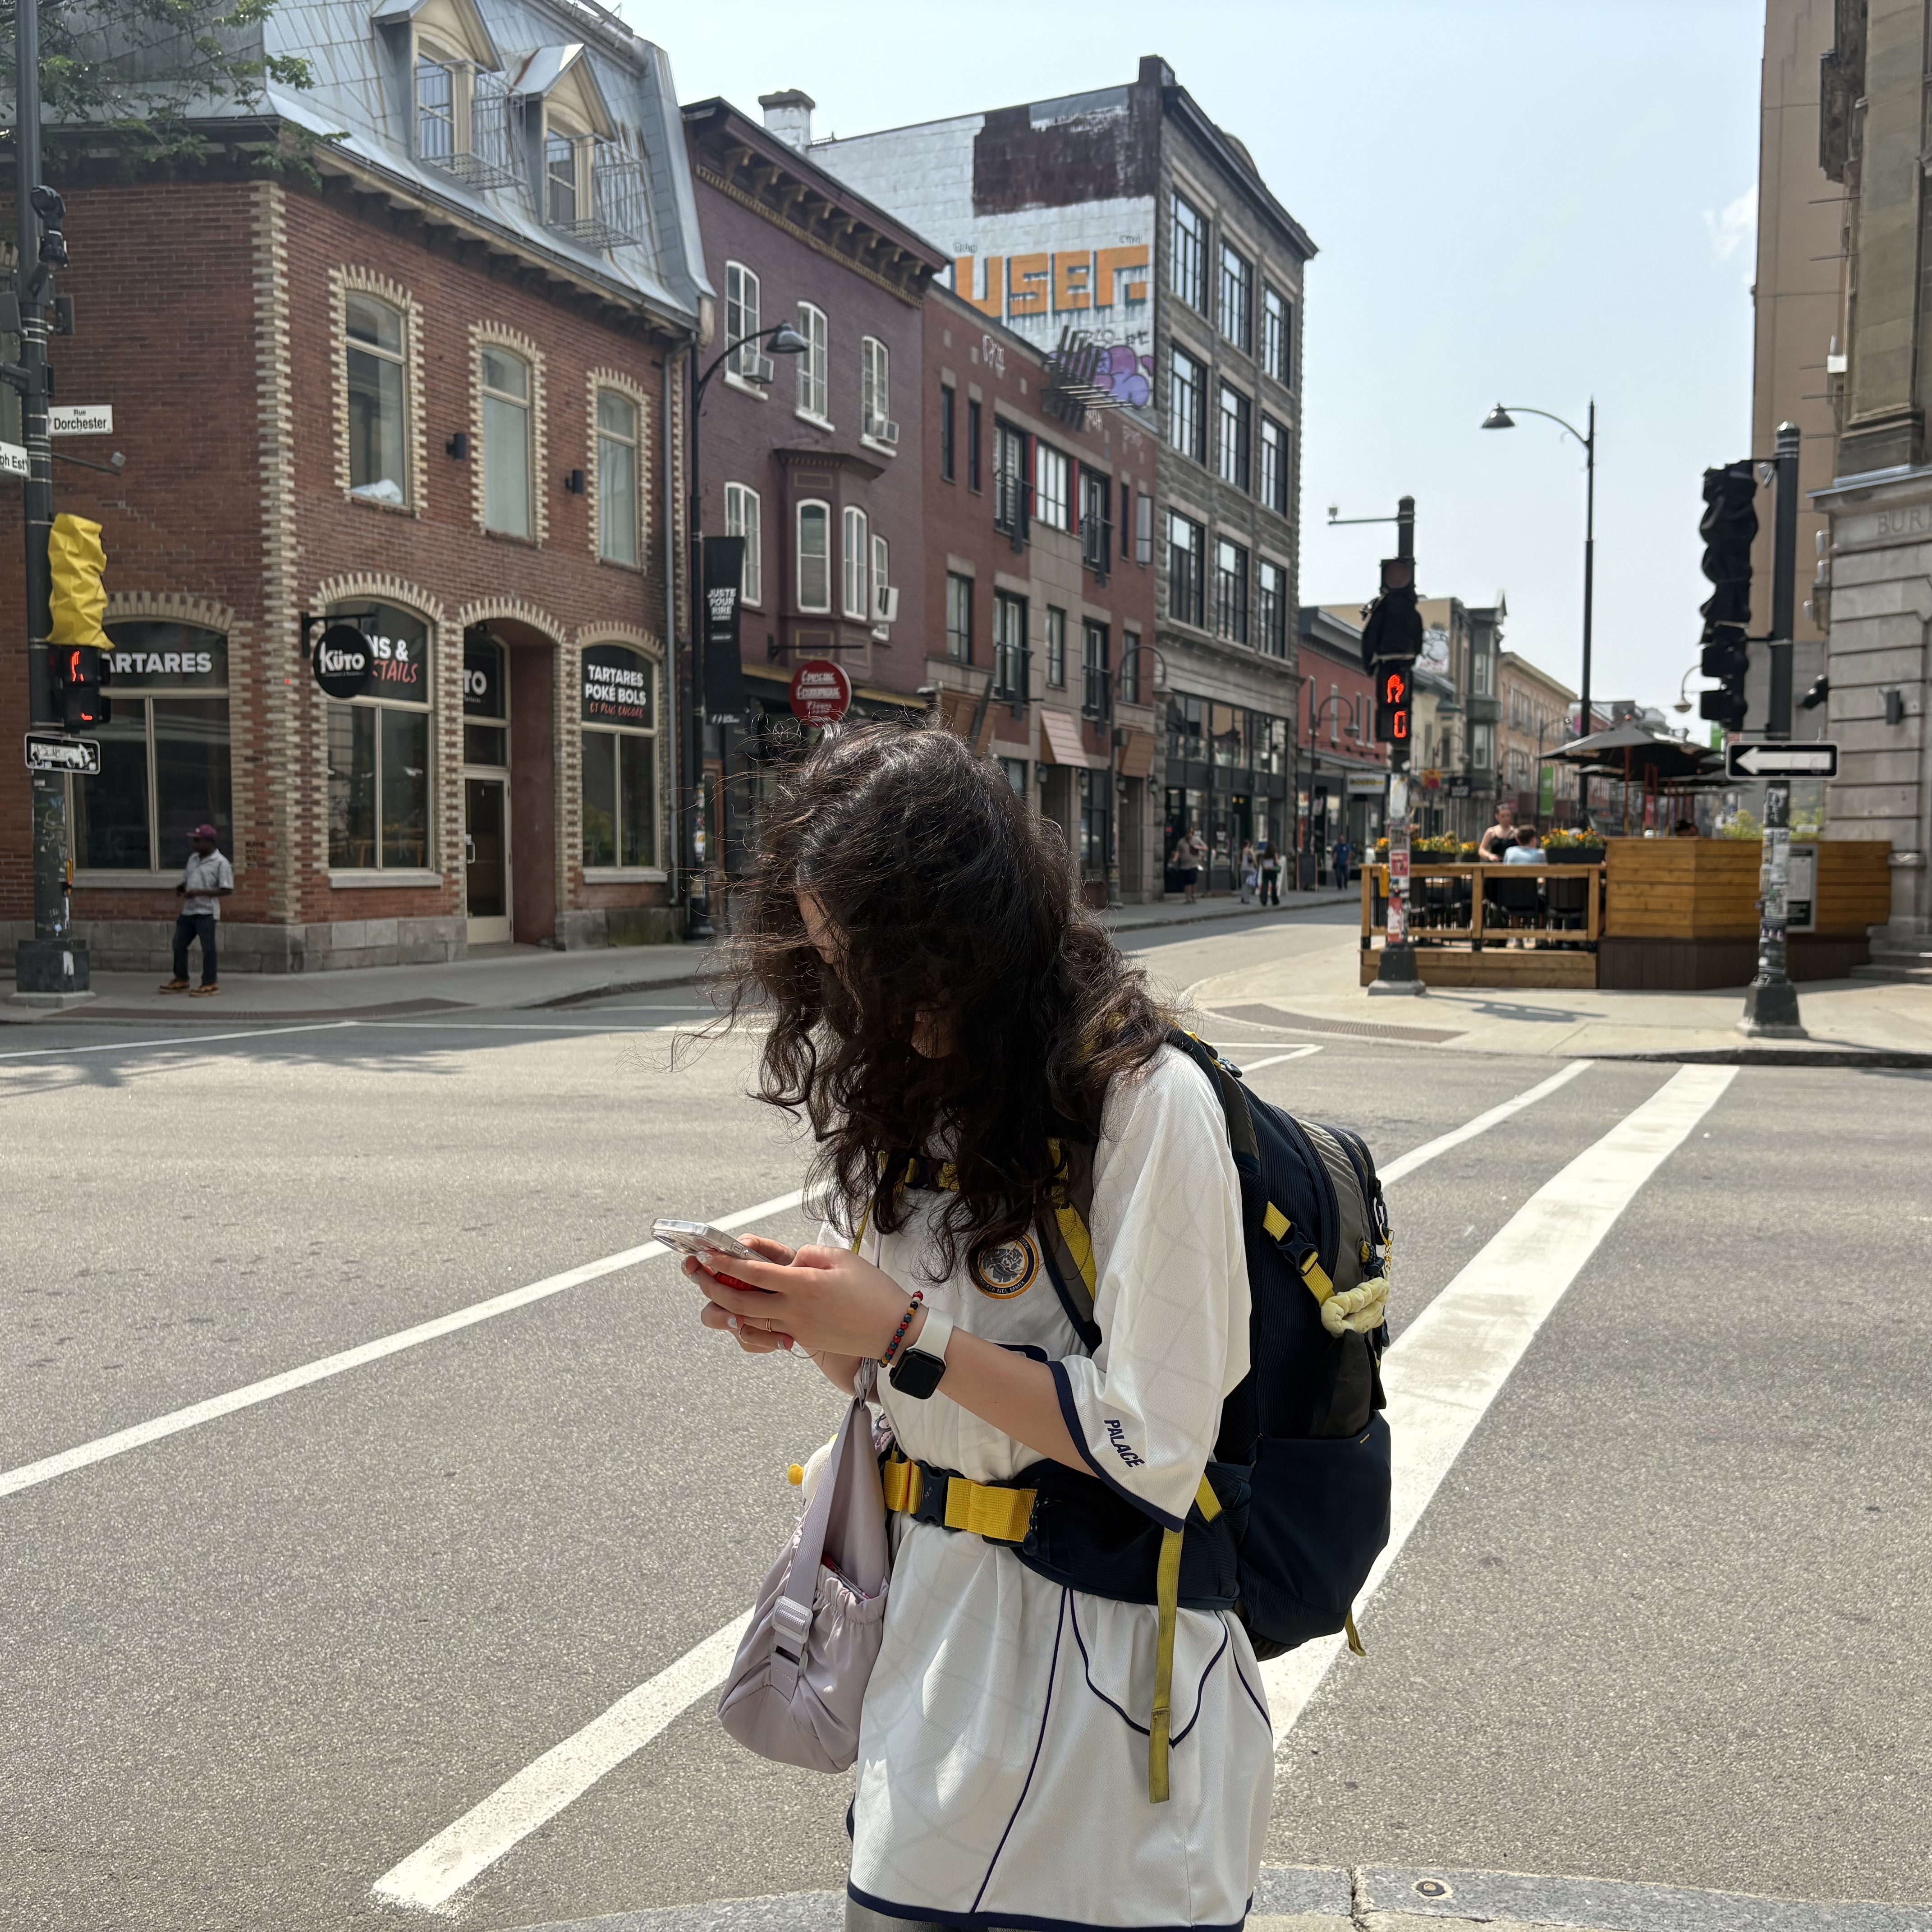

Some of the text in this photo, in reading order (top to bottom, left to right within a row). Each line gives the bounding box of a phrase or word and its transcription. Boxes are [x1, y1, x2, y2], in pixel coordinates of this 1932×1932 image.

[54, 417, 107, 430] Dorchester
[12, 455, 25, 470] Est
[1877, 505, 1932, 536] BUR
[707, 588, 737, 599] JUSTE
[709, 597, 734, 607] POUR
[711, 606, 732, 615] RIRE
[319, 641, 365, 674] KÜTO
[395, 639, 408, 662] &
[588, 664, 643, 687] TARTARES
[585, 682, 646, 706] POKÉ BOLS
[601, 702, 616, 716] PLUS
[1104, 1420, 1145, 1467] PALACE
